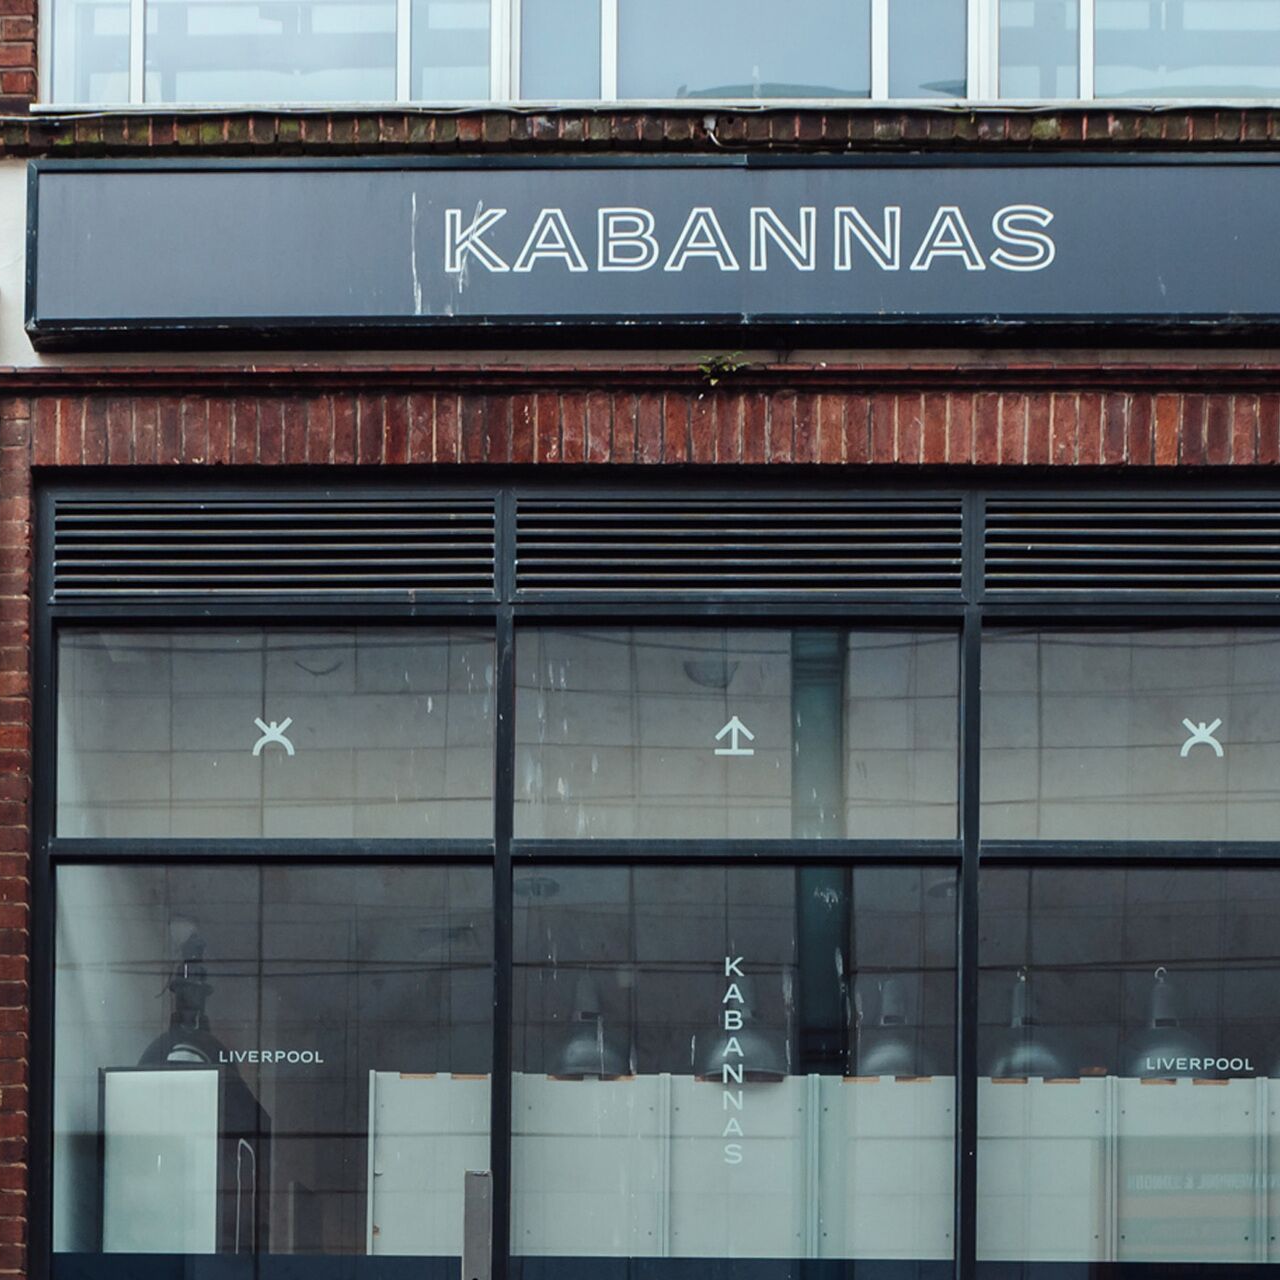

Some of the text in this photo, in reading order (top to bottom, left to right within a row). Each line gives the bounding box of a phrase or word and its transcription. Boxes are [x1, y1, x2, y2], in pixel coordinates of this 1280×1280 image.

[444, 204, 1056, 272] KABANNAS
[219, 1050, 324, 1063] LIVERPOOL
[722, 956, 745, 1165] KABANNAS
[1146, 1057, 1255, 1071] LIVERPOOL
